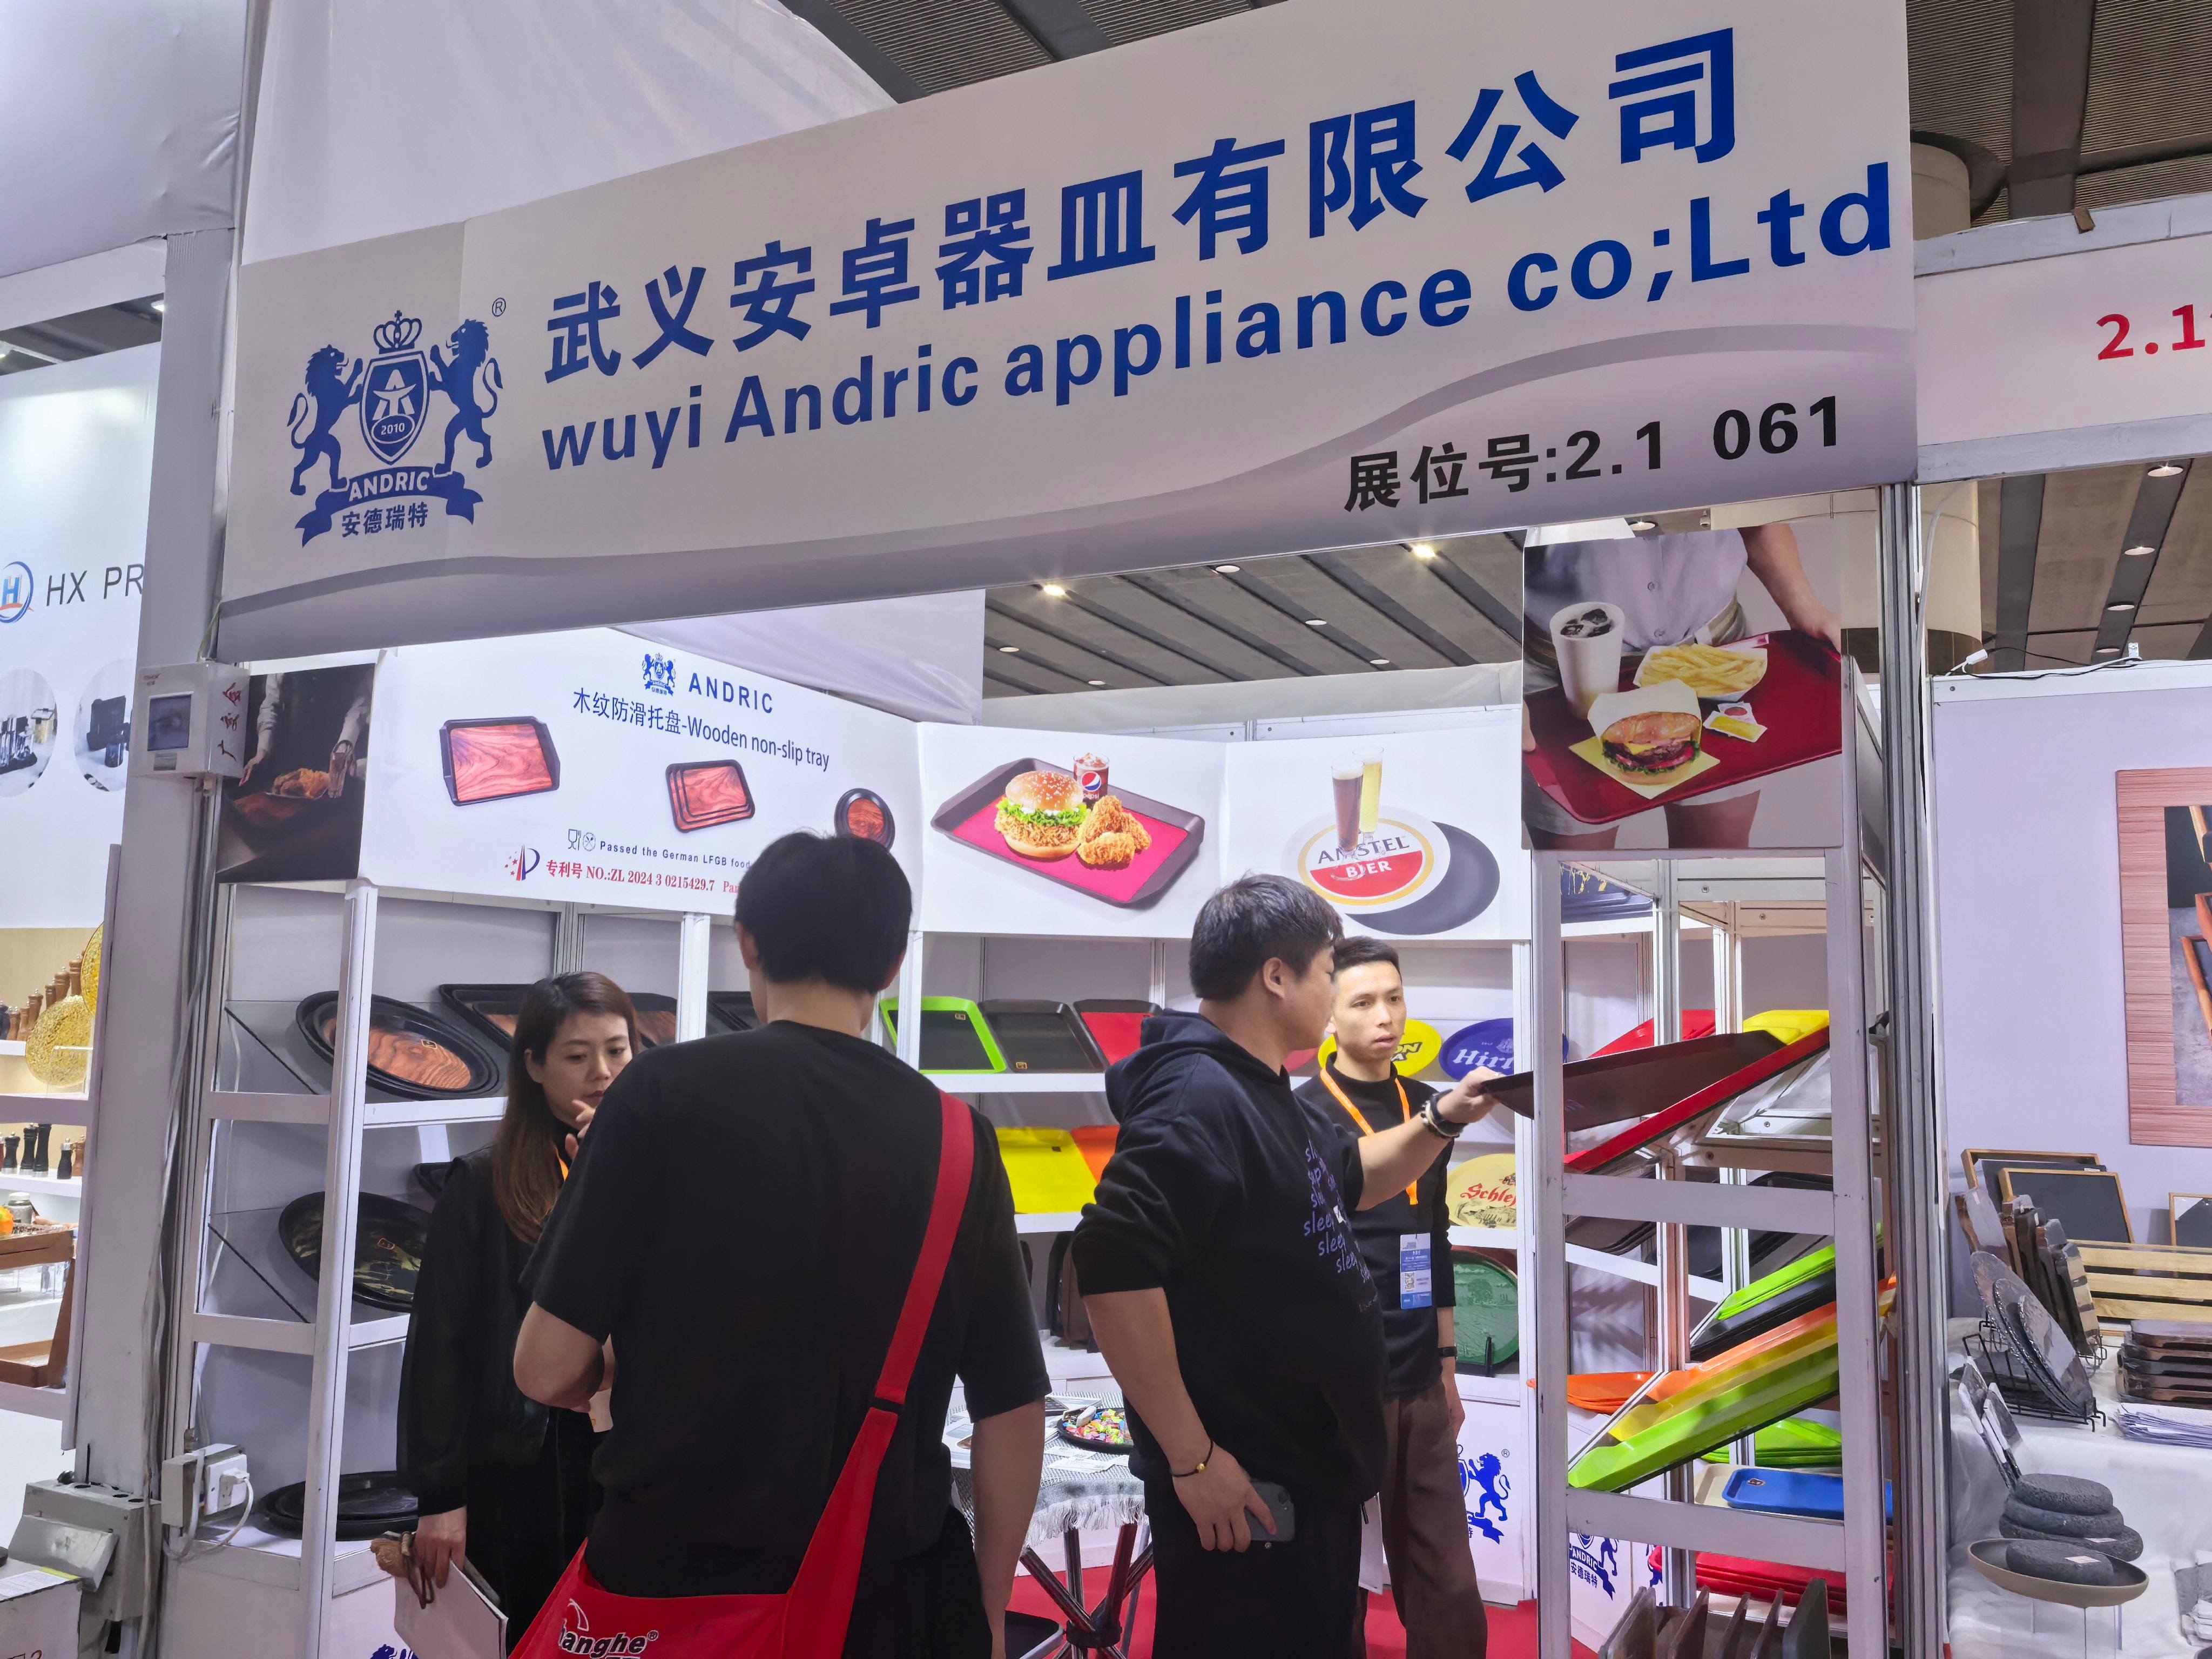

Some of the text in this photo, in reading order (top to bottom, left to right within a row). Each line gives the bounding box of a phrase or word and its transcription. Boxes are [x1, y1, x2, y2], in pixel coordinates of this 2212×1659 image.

[545, 27, 1735, 384] 武义安卓器皿有限公司
[541, 161, 1891, 470] wuyi Andric appliance co;Ltd
[2096, 304, 2212, 361] 2.1
[381, 423, 405, 436] 2010
[1712, 395, 1838, 460] 061
[348, 471, 430, 502] ANDRIC
[342, 501, 428, 537] 安德瑞特
[46, 570, 87, 606] HX
[689, 672, 773, 714] ANDRIC
[751, 737, 803, 766] non-slip
[806, 747, 830, 772] tray
[600, 841, 637, 855] Passed
[642, 847, 658, 858] the
[662, 849, 698, 863] German
[703, 854, 727, 866] LFGB
[1345, 861, 1392, 878] BIER
[546, 859, 583, 879] 专利号
[628, 871, 653, 886] 2024
[656, 874, 662, 886] 3
[665, 875, 715, 892] 0215429.7
[1570, 1561, 1599, 1589] 安德瑞特
[1572, 1548, 1599, 1571] ANDRIC
